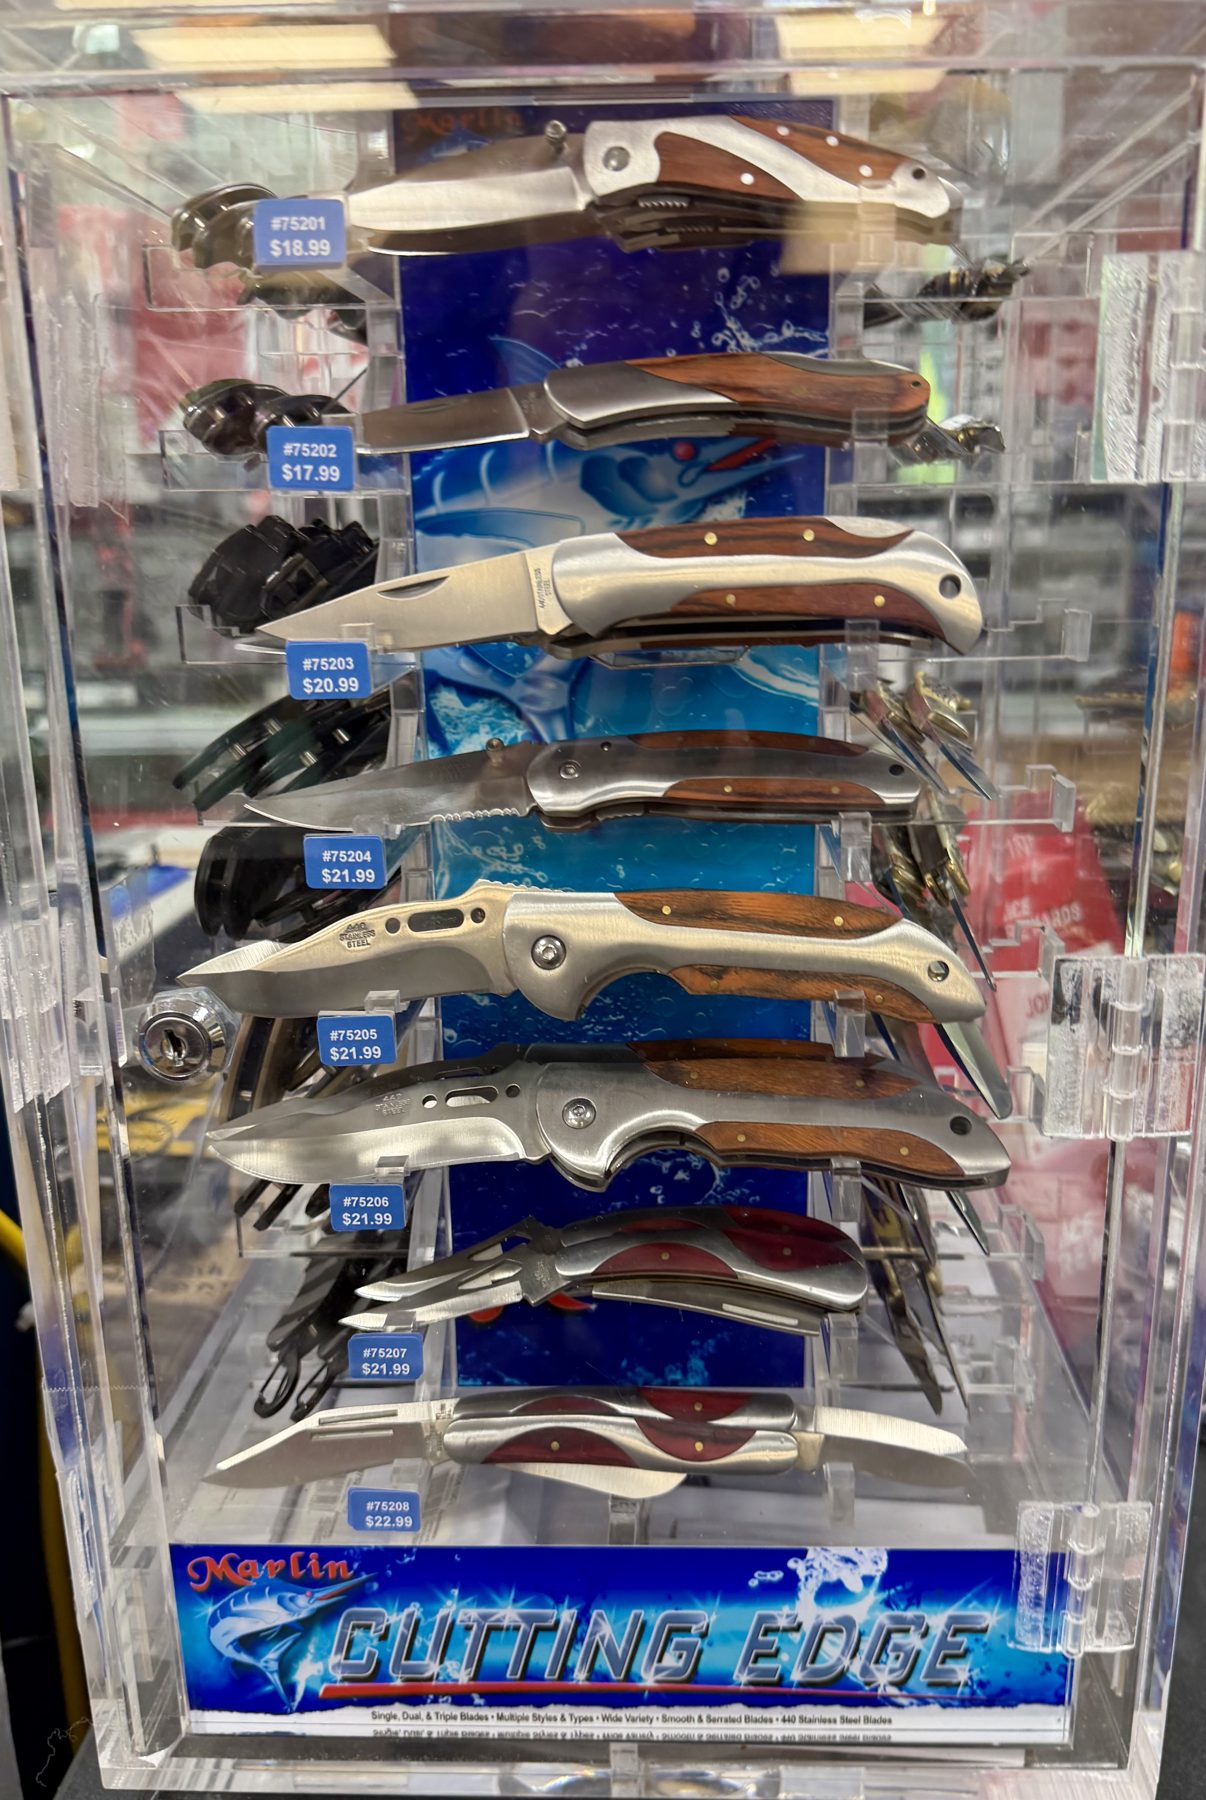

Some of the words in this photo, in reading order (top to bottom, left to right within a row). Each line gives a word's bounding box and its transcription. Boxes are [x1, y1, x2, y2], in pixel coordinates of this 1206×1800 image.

[271, 216, 326, 231] #75201
[270, 239, 331, 257] $18.99
[283, 442, 337, 458] #75202
[281, 464, 341, 482] $17.99
[302, 657, 354, 671] #75203
[302, 677, 359, 694] $20.99
[322, 850, 372, 863] #75204
[321, 868, 376, 883] $21.99
[347, 940, 371, 948] STEEL
[329, 1028, 378, 1041] #75205
[329, 1045, 382, 1061] $21.99
[343, 1196, 389, 1207] #75206
[342, 1212, 393, 1225] $21.99
[363, 1347, 407, 1358] #75207
[361, 1362, 410, 1375] $21.99
[366, 1501, 410, 1512] #75208
[365, 1515, 413, 1528] $22.99
[187, 1552, 354, 1592] Marlin
[329, 1608, 708, 1682] CUTTING
[733, 1611, 990, 1685] EDGE
[371, 1711, 400, 1722] Single,
[402, 1711, 422, 1721] Dual,
[426, 1712, 432, 1720] &
[435, 1712, 458, 1723] Triple
[460, 1712, 489, 1721] Blades
[497, 1712, 529, 1723] Multiple
[532, 1713, 558, 1724] Styles
[560, 1713, 566, 1722] &
[569, 1713, 594, 1724] Types
[602, 1714, 623, 1723] Wide
[625, 1714, 654, 1725] Variety
[661, 1714, 695, 1723] Smooth
[697, 1715, 703, 1723] &
[706, 1715, 742, 1724] Serrated
[744, 1715, 773, 1724] Blades
[781, 1715, 796, 1724] 440
[799, 1715, 838, 1725] Stainless
[839, 1715, 861, 1725] Steel
[863, 1716, 893, 1725] Blades
